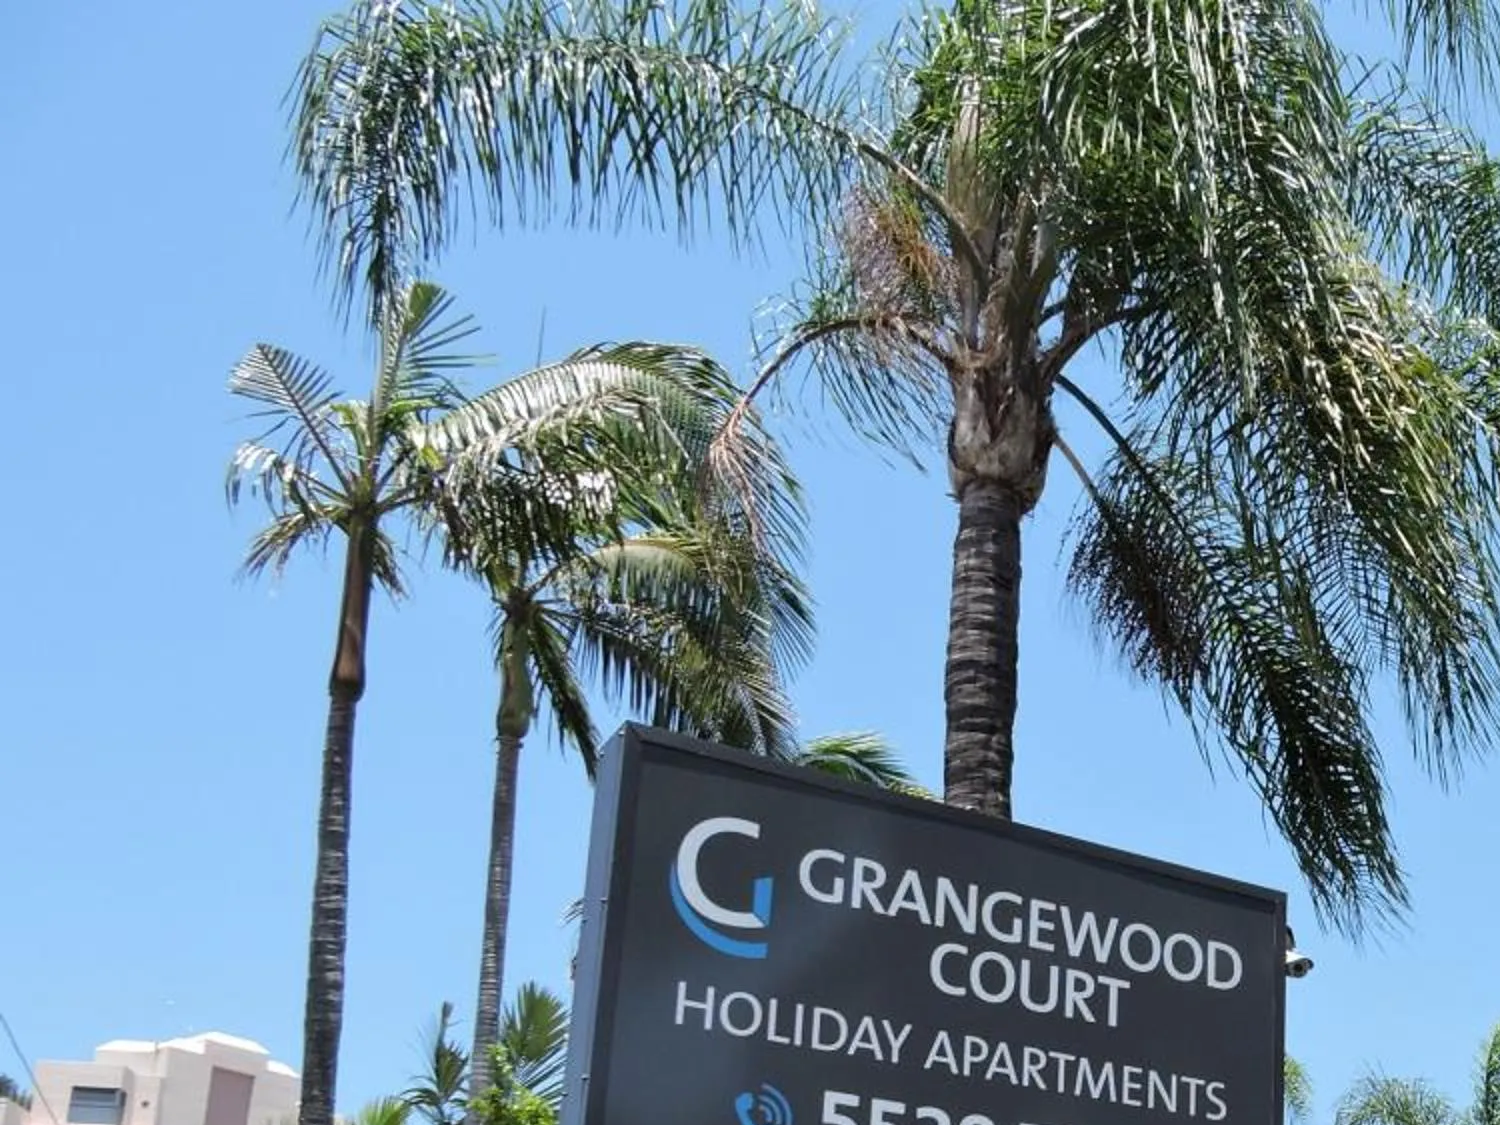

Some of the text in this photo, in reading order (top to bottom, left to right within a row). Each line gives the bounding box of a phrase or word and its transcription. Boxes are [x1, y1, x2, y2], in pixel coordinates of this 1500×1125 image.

[799, 848, 1243, 991] GRANGEWOOD
[929, 942, 1131, 1027] COURT
[674, 981, 1228, 1121] HOLIDAY APARTMENTS
